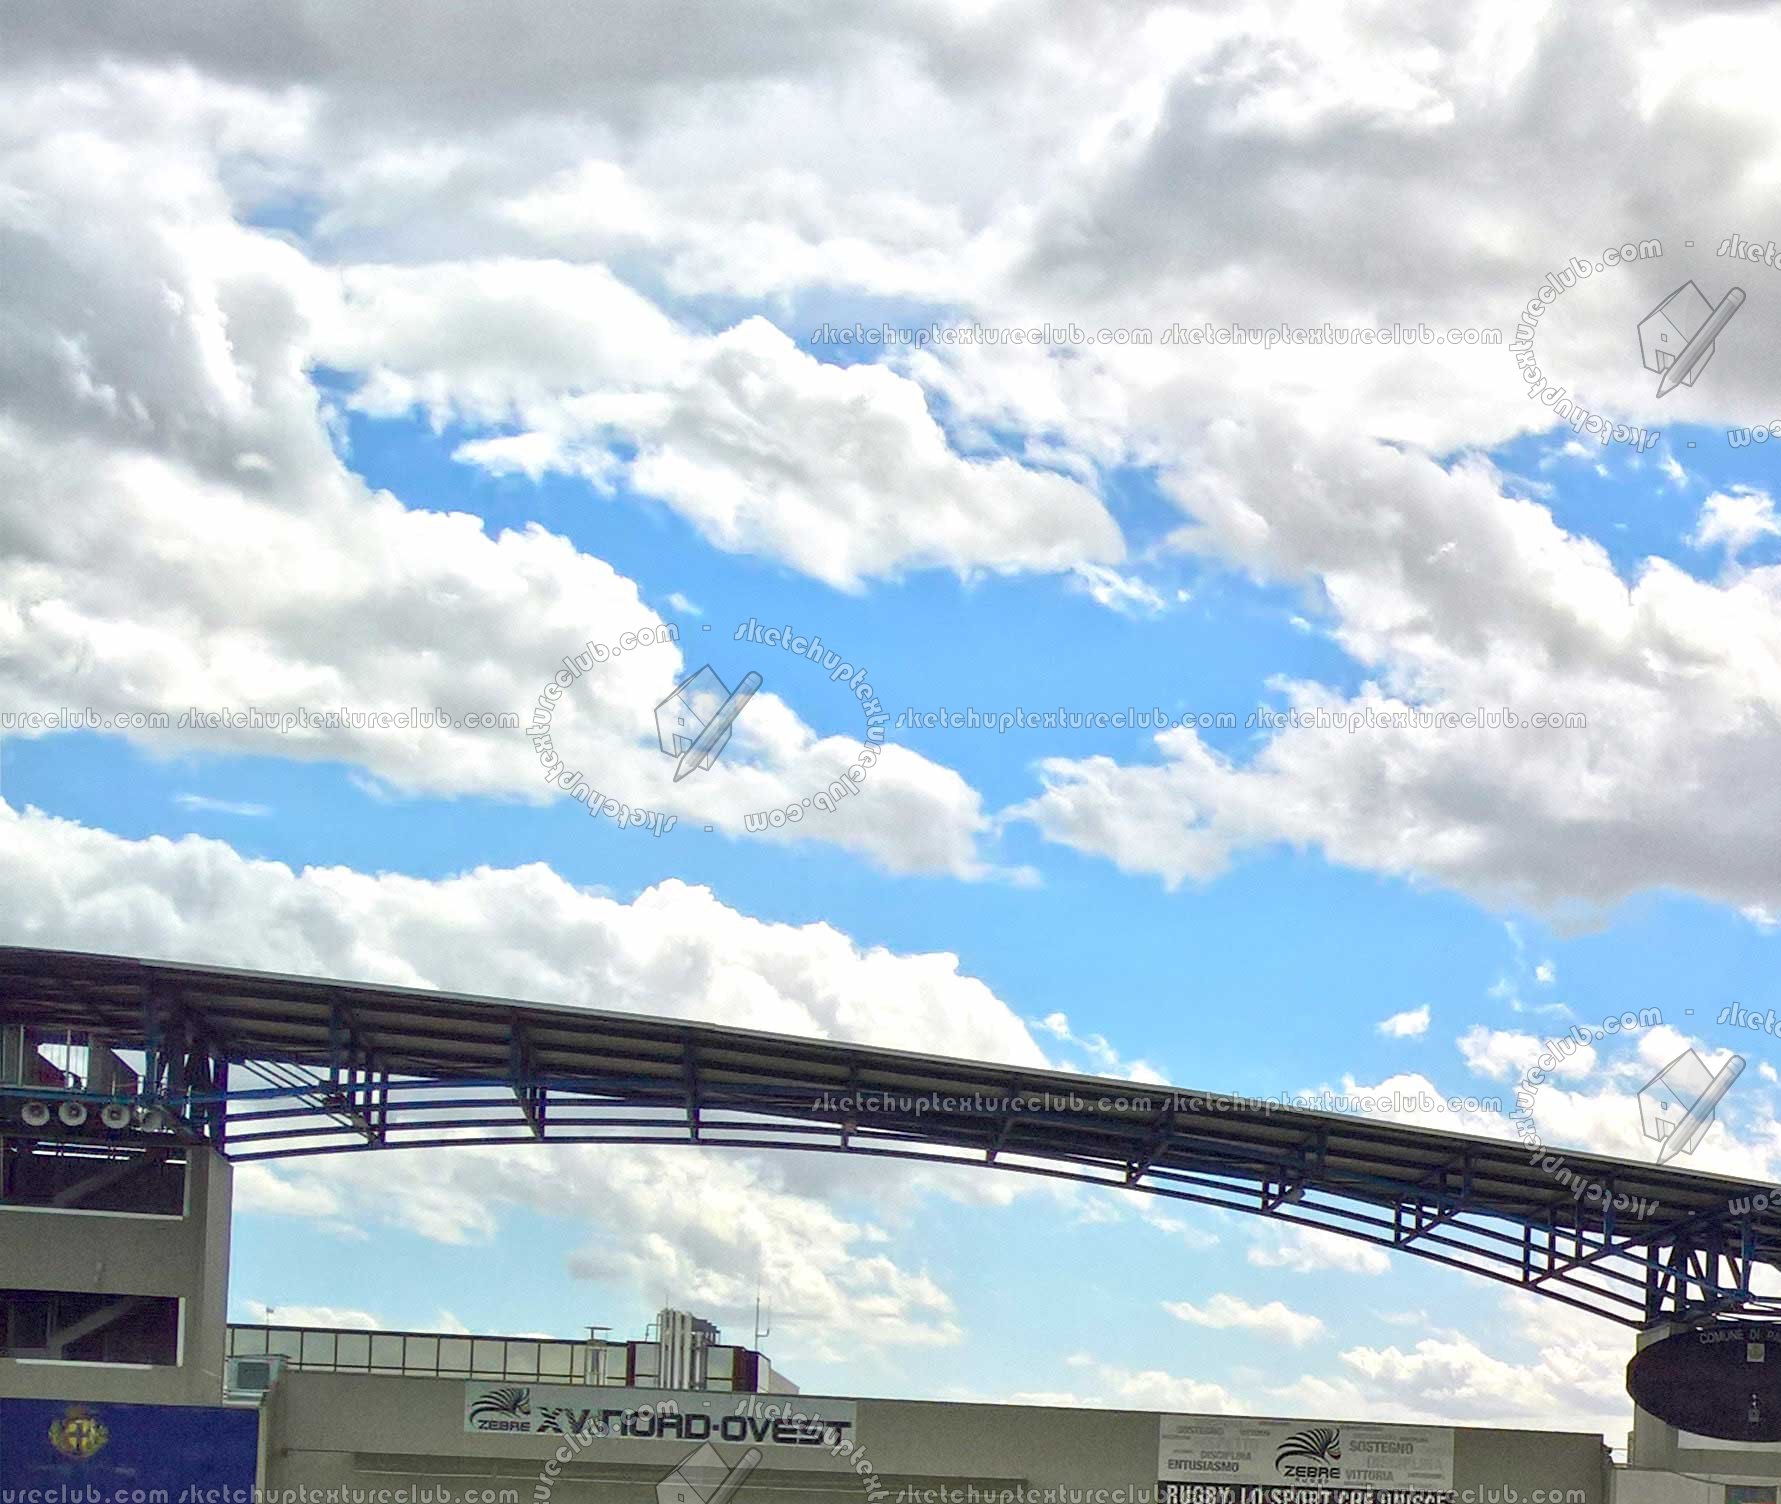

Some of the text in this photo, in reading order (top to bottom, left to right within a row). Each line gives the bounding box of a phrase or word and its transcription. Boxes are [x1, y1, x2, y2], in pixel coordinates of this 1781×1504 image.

[478, 1420, 530, 1431] ZEBRE
[536, 1406, 591, 1434] XV
[1168, 1459, 1239, 1472] ENTUSIASMO
[1284, 1466, 1340, 1479] ZEBRE
